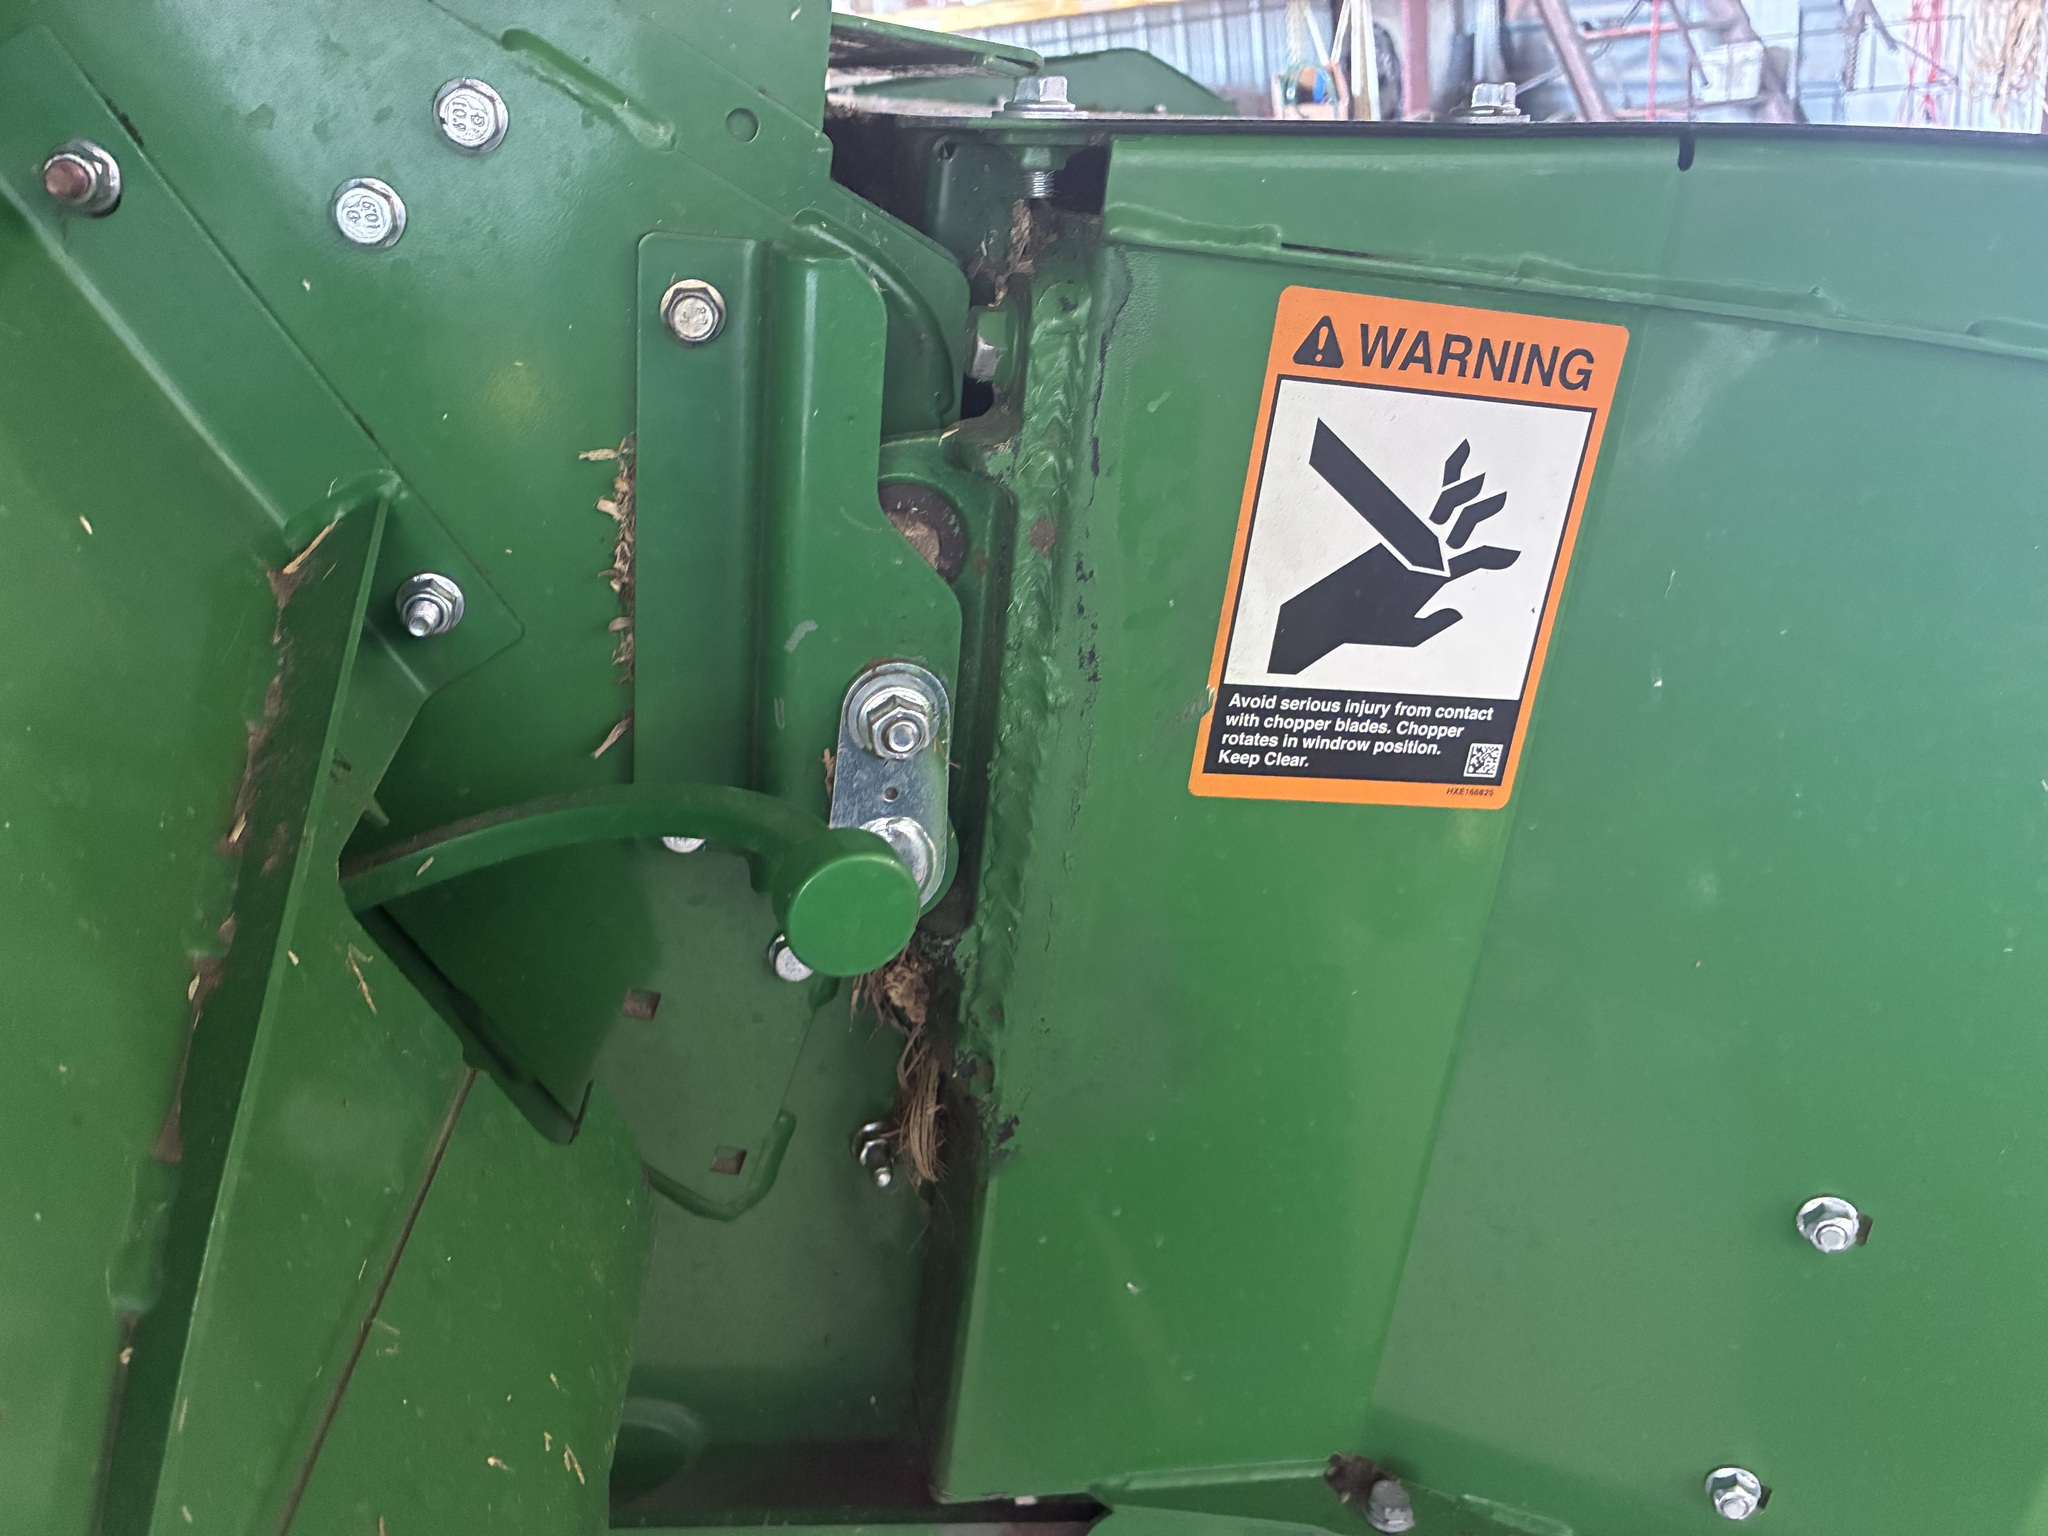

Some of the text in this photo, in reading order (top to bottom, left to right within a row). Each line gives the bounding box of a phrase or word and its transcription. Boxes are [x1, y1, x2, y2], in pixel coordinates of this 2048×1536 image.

[1360, 323, 1595, 391] WARNING
[1228, 692, 1494, 721] Avoid serious injury from contact
[1225, 713, 1465, 740] with chopper blades. Chopper
[1221, 731, 1441, 755] rotates in windrow position.
[1218, 749, 1309, 768] Keep Clear.
